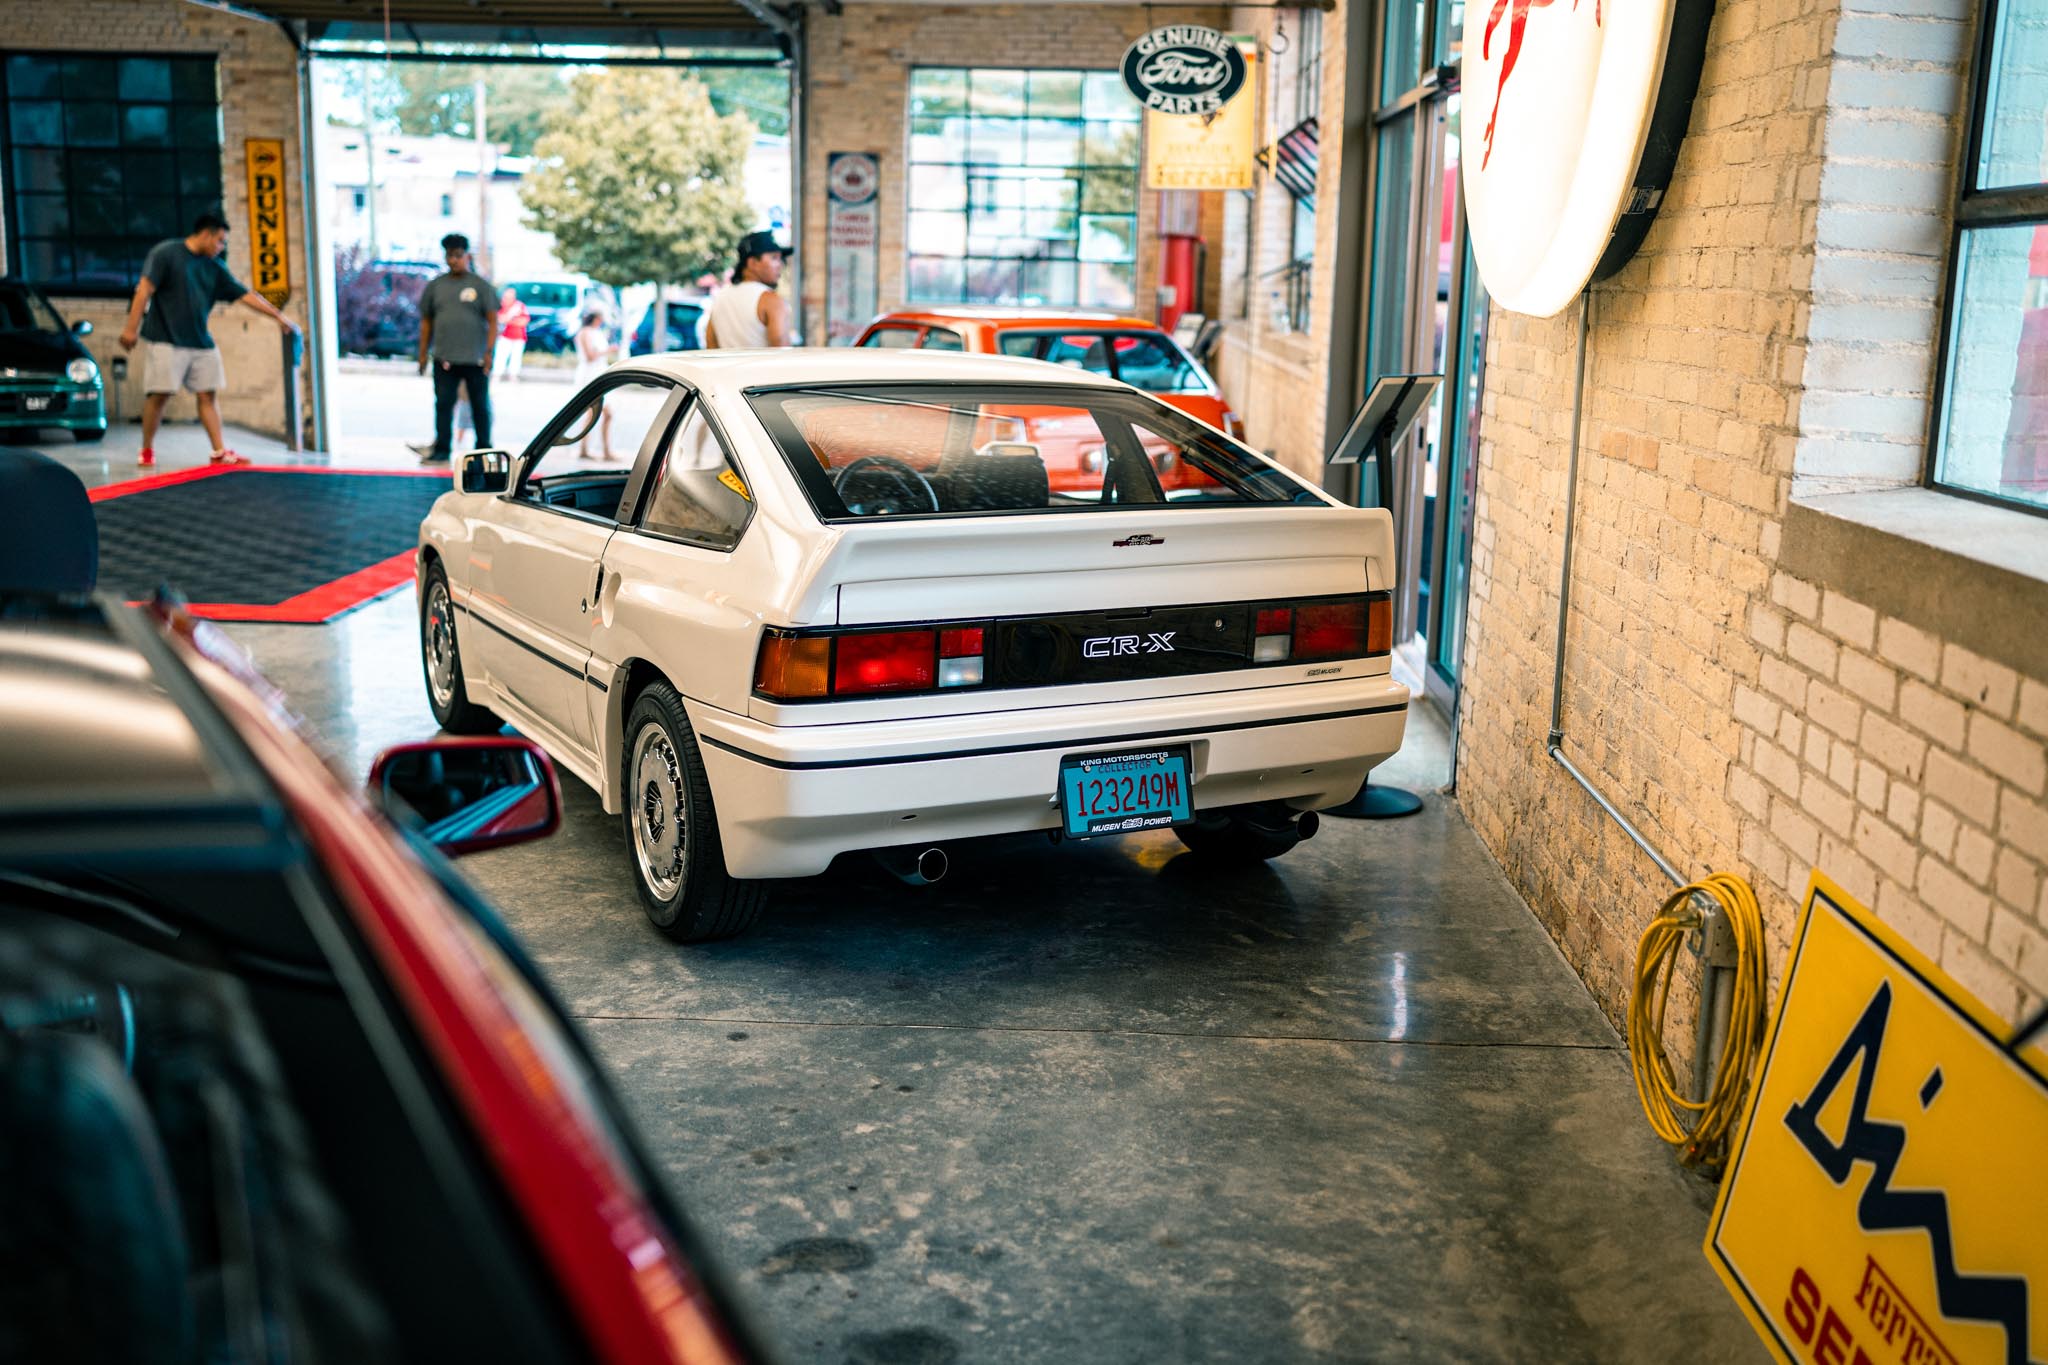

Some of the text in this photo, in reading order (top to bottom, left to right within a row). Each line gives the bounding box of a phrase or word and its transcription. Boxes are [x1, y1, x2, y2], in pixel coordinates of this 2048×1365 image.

[1137, 27, 1231, 55] GENUINE
[1141, 51, 1225, 86] Ford
[1147, 91, 1222, 114] PARTS
[255, 174, 281, 287] DUNLOP
[1083, 631, 1176, 658] CR-X
[1103, 752, 1168, 763] MOTORSPORTS
[1077, 771, 1180, 817] 123249M
[1091, 822, 1121, 833] MUGEN
[1143, 816, 1172, 826] POWER
[1784, 1266, 1876, 1365] SE
